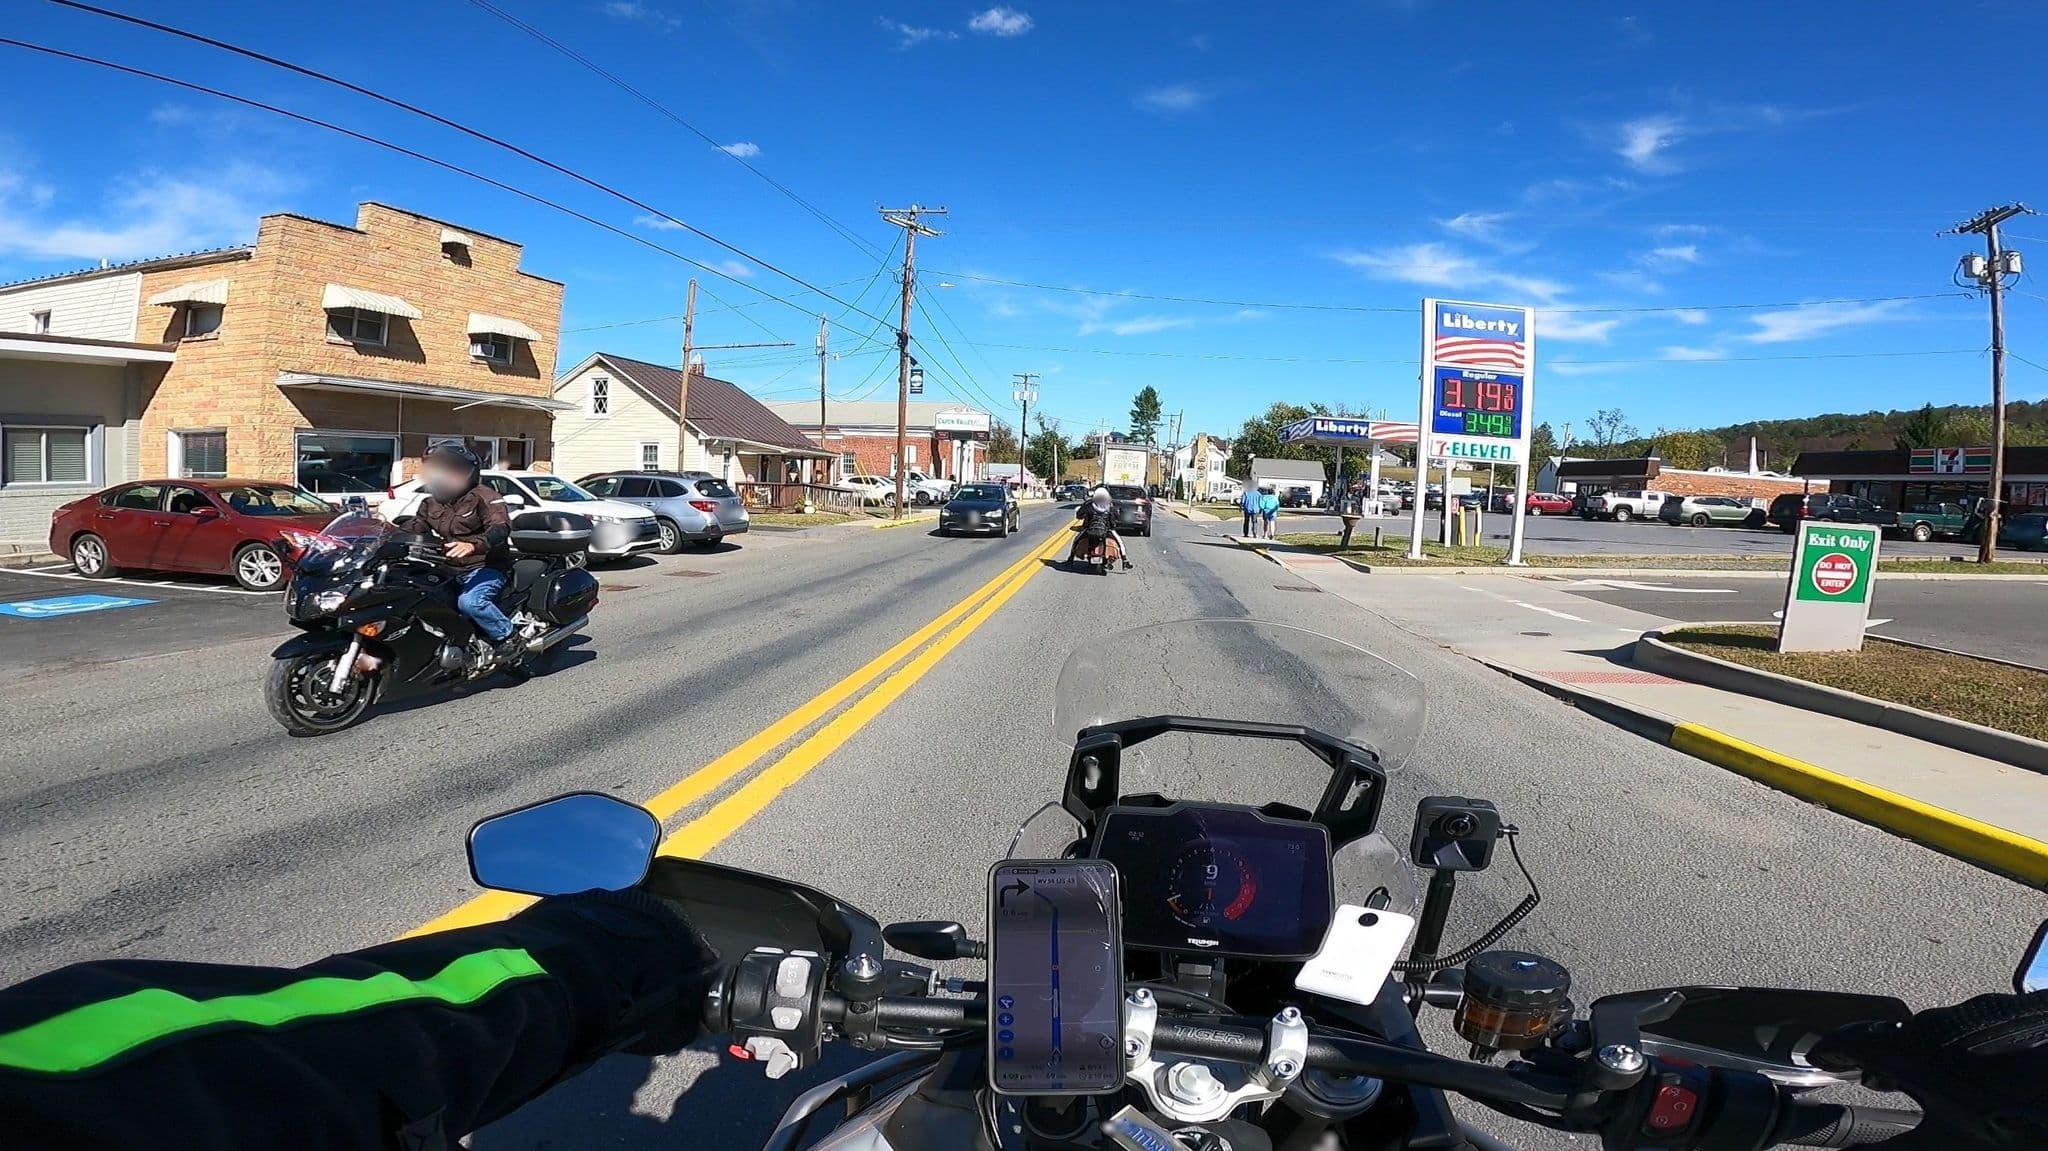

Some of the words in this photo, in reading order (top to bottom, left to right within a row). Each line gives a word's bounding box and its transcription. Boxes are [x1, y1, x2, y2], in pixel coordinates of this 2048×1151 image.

[1443, 312, 1519, 336] Liberty
[1462, 370, 1498, 380] Regular
[1446, 380, 1501, 411] 3.19
[1440, 410, 1462, 418] Diesel
[1316, 420, 1368, 436] Liberty
[1466, 412, 1504, 434] 3.49
[1808, 533, 1836, 547] Exit
[1839, 535, 1870, 552] Only
[1835, 562, 1852, 570] NOT
[1821, 579, 1846, 588] ENTER
[1206, 864, 1218, 880] 9
[1174, 1025, 1246, 1045] TIGER
